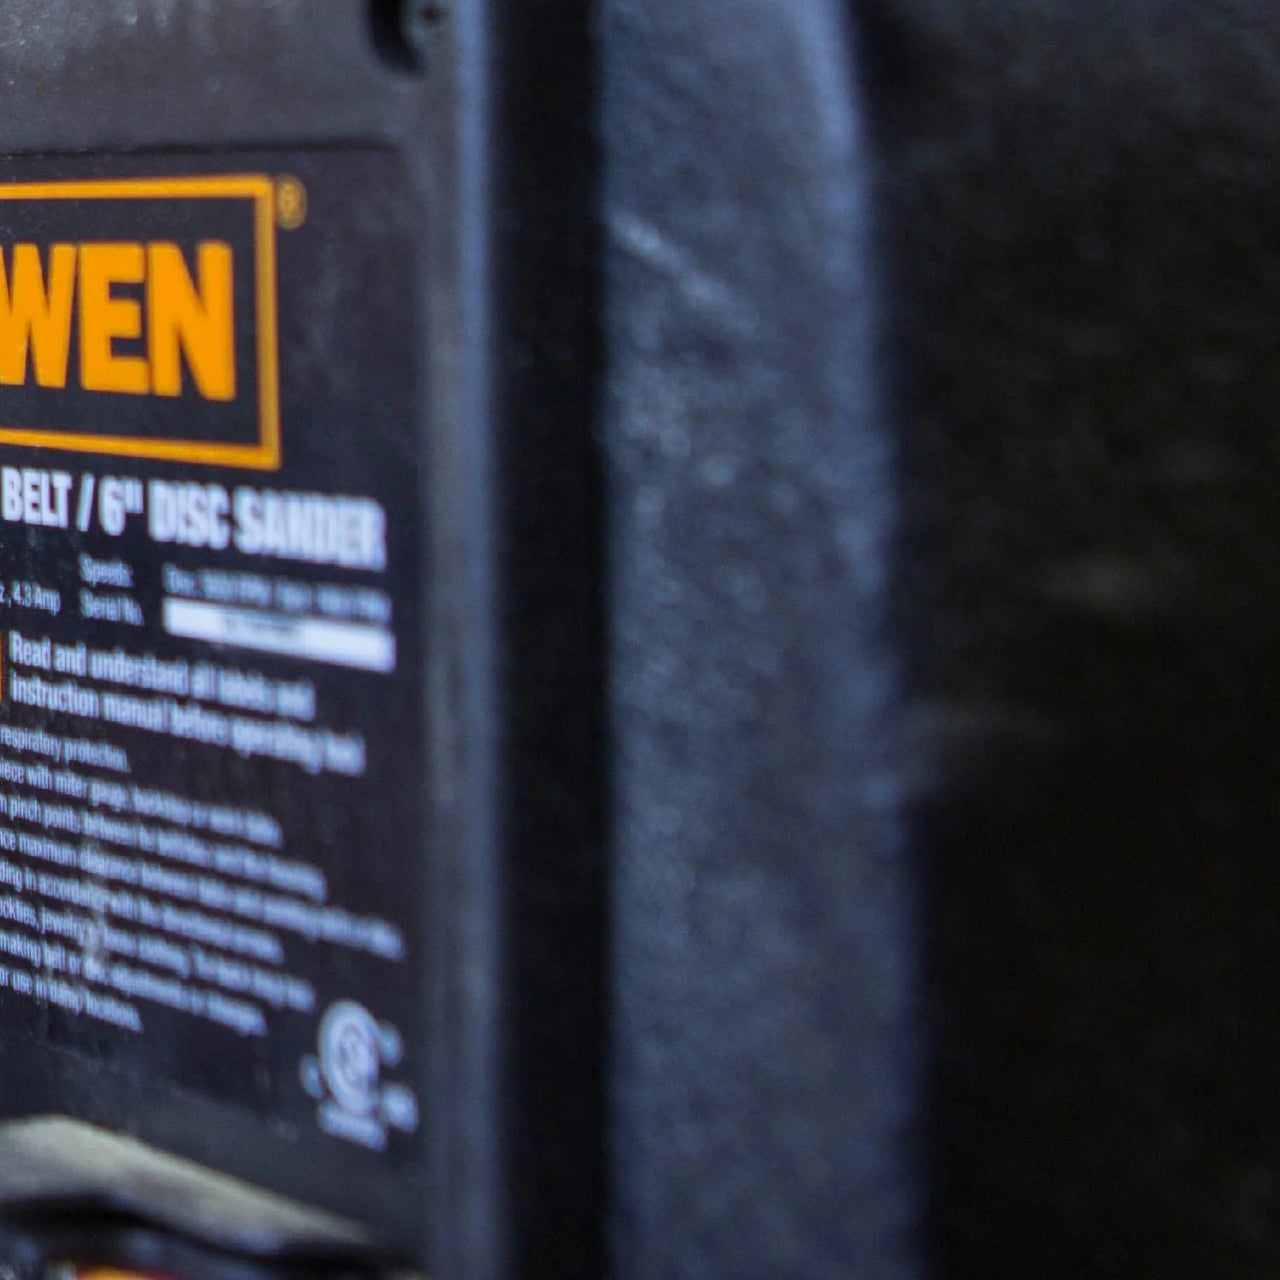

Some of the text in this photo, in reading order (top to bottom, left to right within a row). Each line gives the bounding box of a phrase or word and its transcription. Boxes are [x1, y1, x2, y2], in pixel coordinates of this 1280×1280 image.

[0, 465, 73, 530] BELT
[75, 472, 96, 532] /
[98, 474, 145, 537] 6"
[147, 477, 232, 551] DISC
[232, 484, 389, 573] SANDER
[34, 585, 62, 616] Amp
[9, 629, 52, 671] Read
[53, 640, 88, 677] and
[90, 646, 190, 697] understand
[101, 691, 169, 734] manual
[0, 722, 63, 764] respiratory
[26, 763, 54, 791] with
[9, 794, 41, 824] pinch
[18, 831, 80, 869] maximum
[11, 973, 33, 996] use
